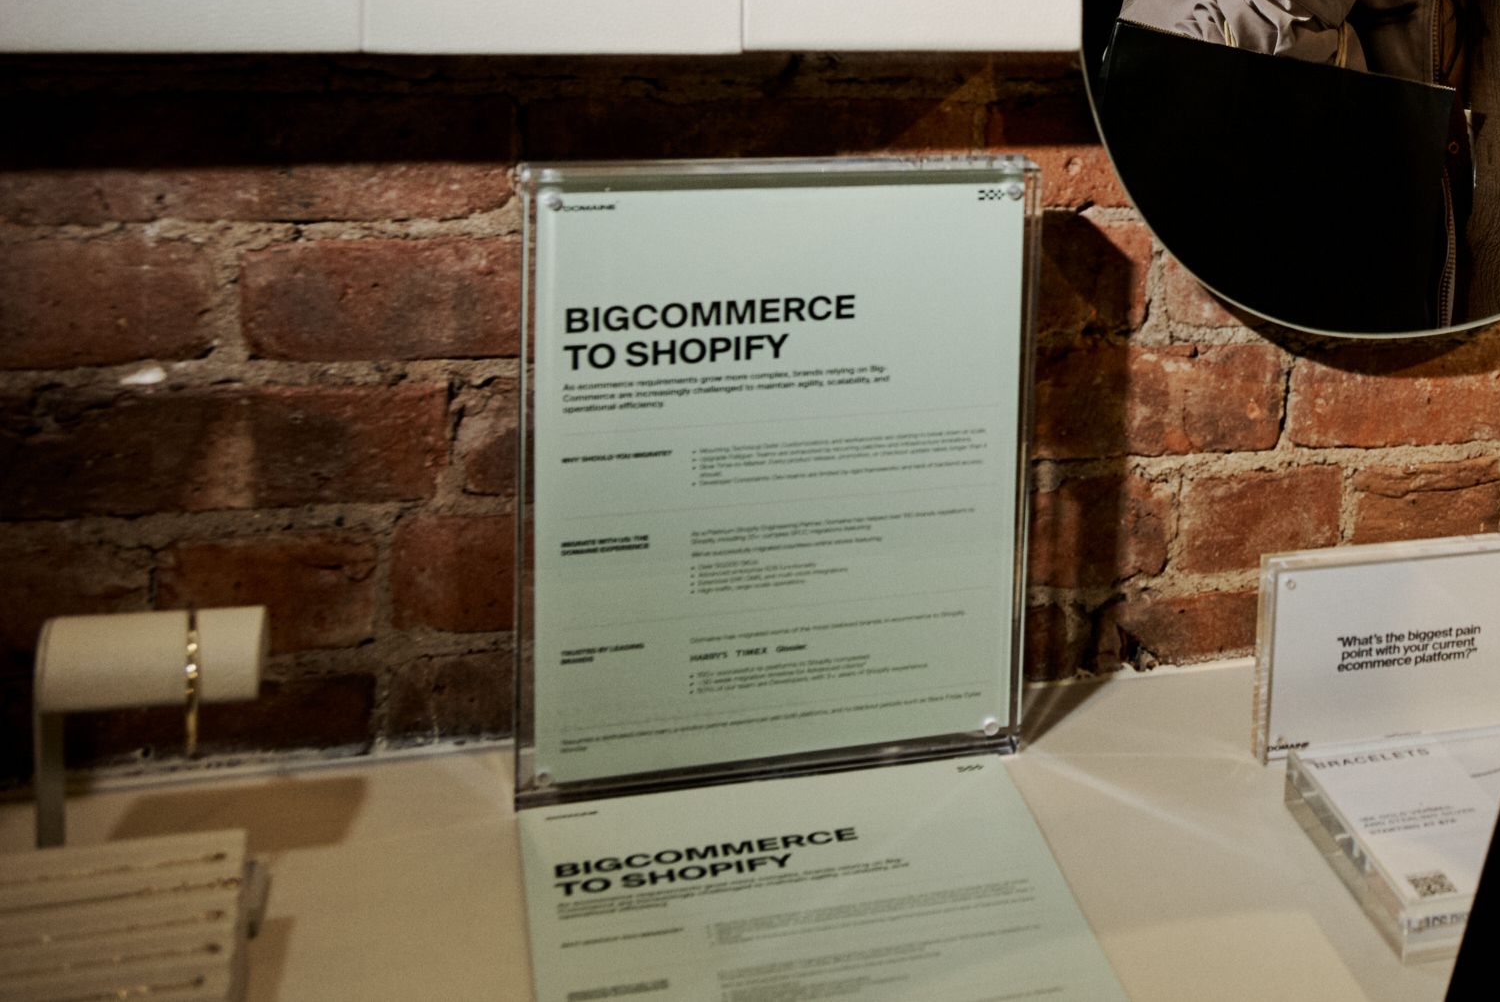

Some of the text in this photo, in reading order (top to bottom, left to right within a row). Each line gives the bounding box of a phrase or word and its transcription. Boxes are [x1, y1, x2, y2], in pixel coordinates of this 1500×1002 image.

[564, 294, 856, 334] BIGCOMMERCE
[564, 333, 789, 370] TO SHOPIFY
[1337, 624, 1481, 648] "What's the biggest pain
[1341, 637, 1475, 661] point with your current
[1337, 648, 1478, 672] ecommerce platform?"
[1312, 747, 1430, 770] BRACELETS
[553, 827, 859, 879] BIGCOMMERCE
[555, 877, 612, 898] TO
[621, 853, 793, 890] SHOPIFY
